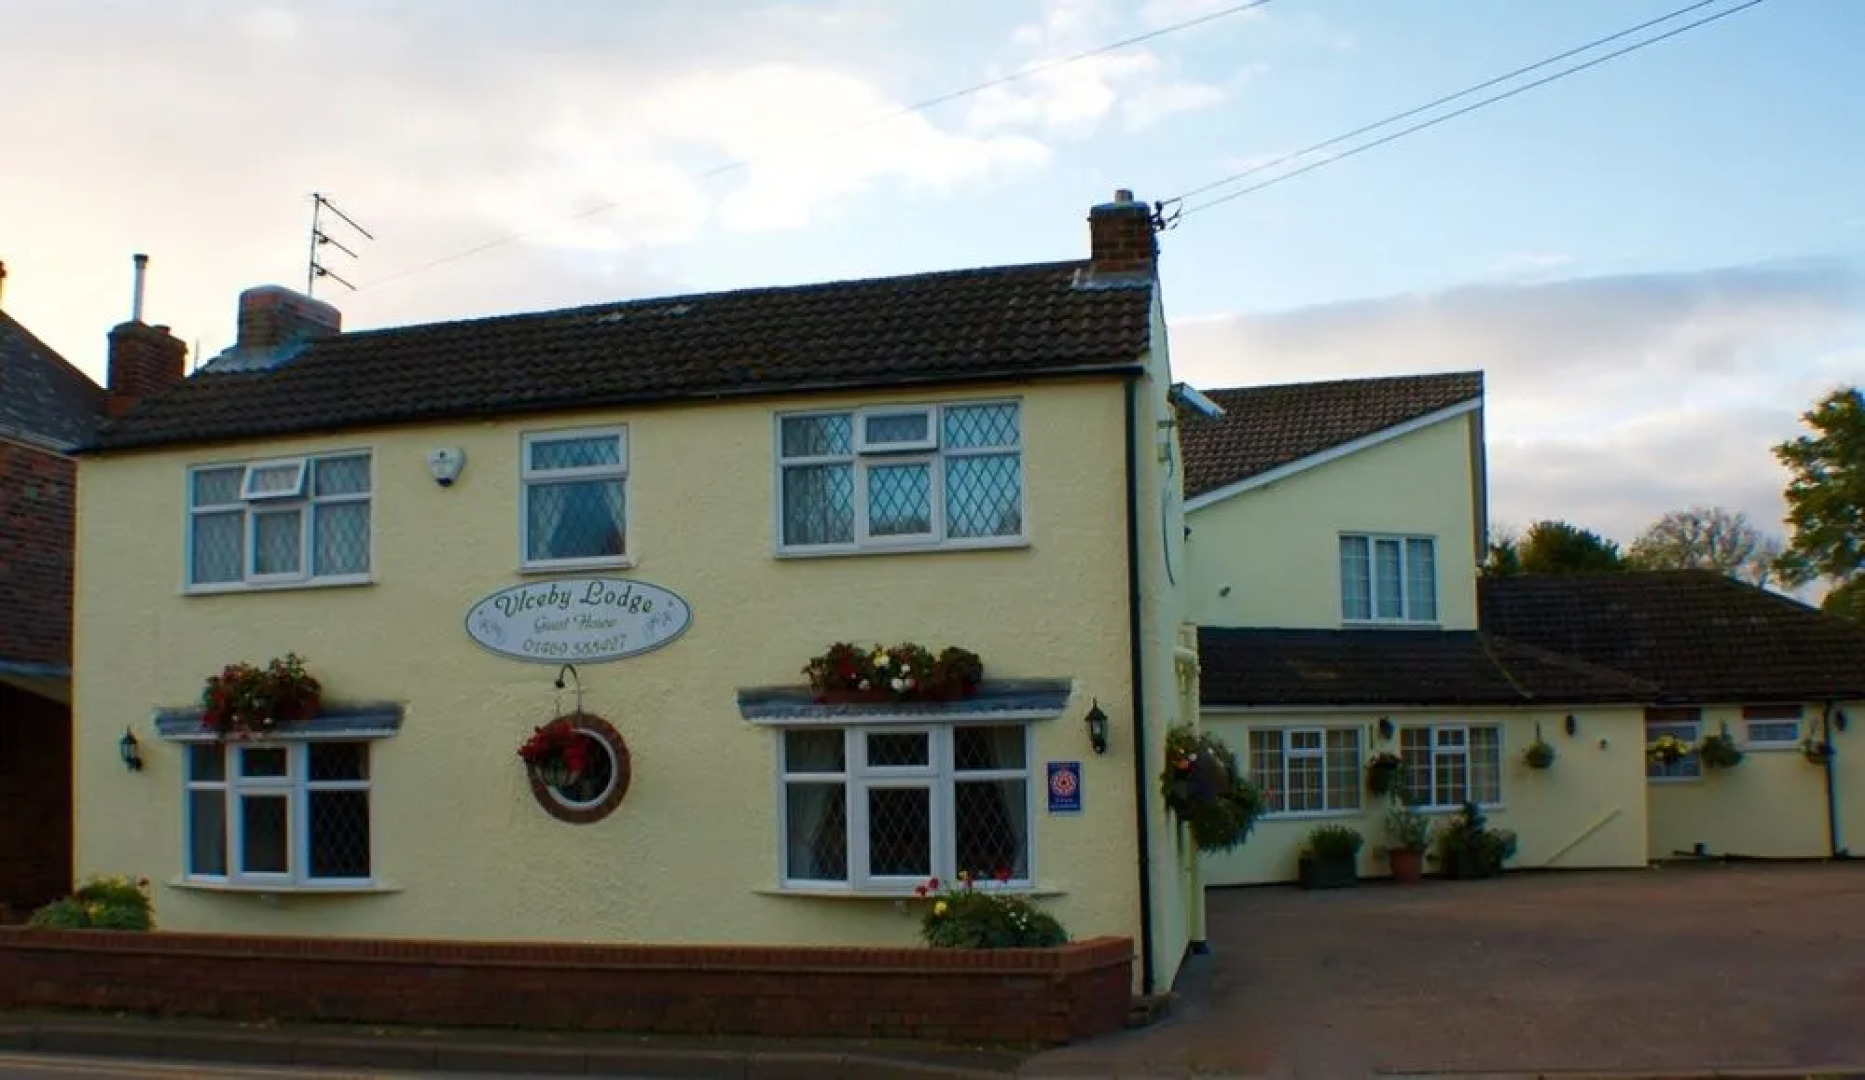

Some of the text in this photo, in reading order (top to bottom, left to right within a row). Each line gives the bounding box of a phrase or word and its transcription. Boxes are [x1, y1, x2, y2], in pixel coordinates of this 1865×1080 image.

[493, 581, 654, 618] Ulceby Lodge
[534, 612, 618, 633] Guest House
